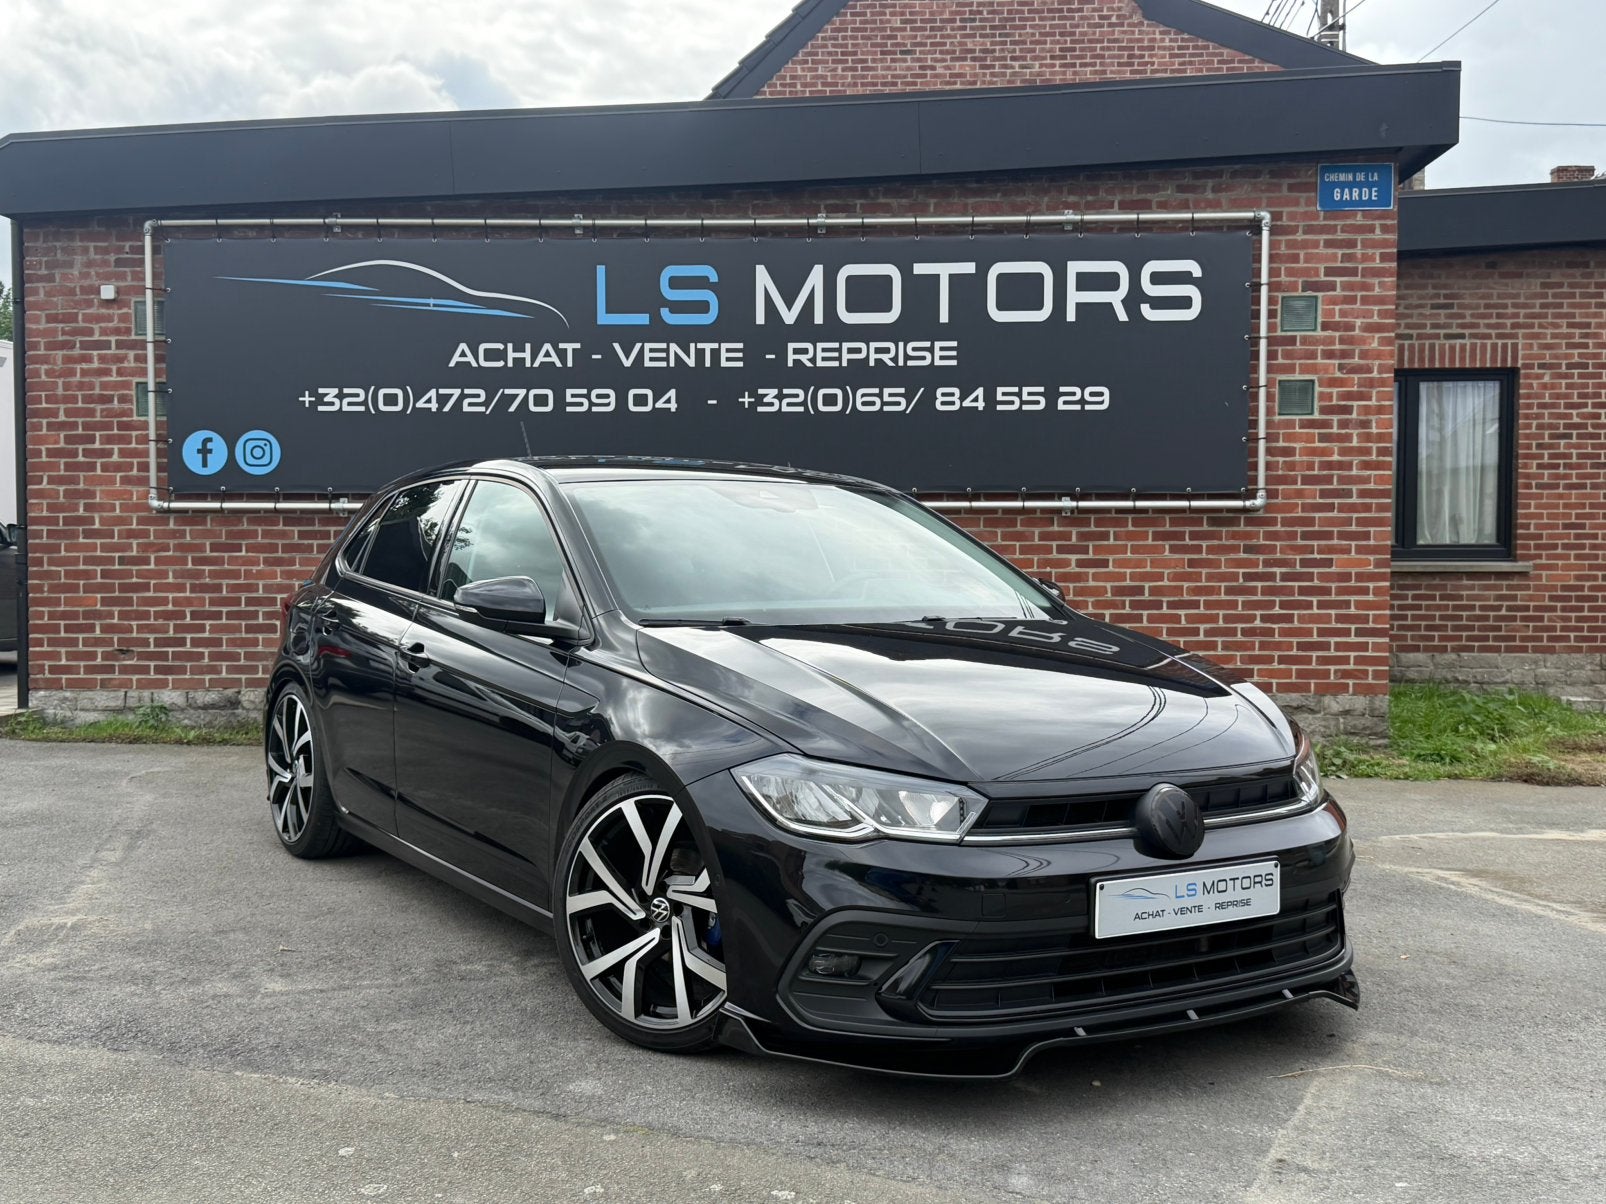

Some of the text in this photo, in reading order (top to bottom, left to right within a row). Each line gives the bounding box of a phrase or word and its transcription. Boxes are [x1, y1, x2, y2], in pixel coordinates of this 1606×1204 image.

[1324, 172, 1379, 182] CHEMIN DE LA
[1333, 187, 1379, 201] GARDE
[596, 259, 1203, 326] LS MOTORS
[448, 342, 582, 368] ACHAT
[611, 342, 744, 368] VENTE
[787, 340, 958, 368] REPRISE
[298, 385, 554, 415] +32(0)472/70
[565, 388, 616, 413] 59
[627, 388, 678, 413] 04
[737, 385, 925, 415] +32(0)65/
[934, 386, 986, 412] 84
[996, 386, 1046, 411] 55
[1057, 385, 1110, 411] 29
[1174, 872, 1274, 899] LS MOTORS
[1133, 909, 1166, 921] ACHAT
[1173, 904, 1204, 917] VENTE
[1214, 897, 1252, 911] REPRISE
